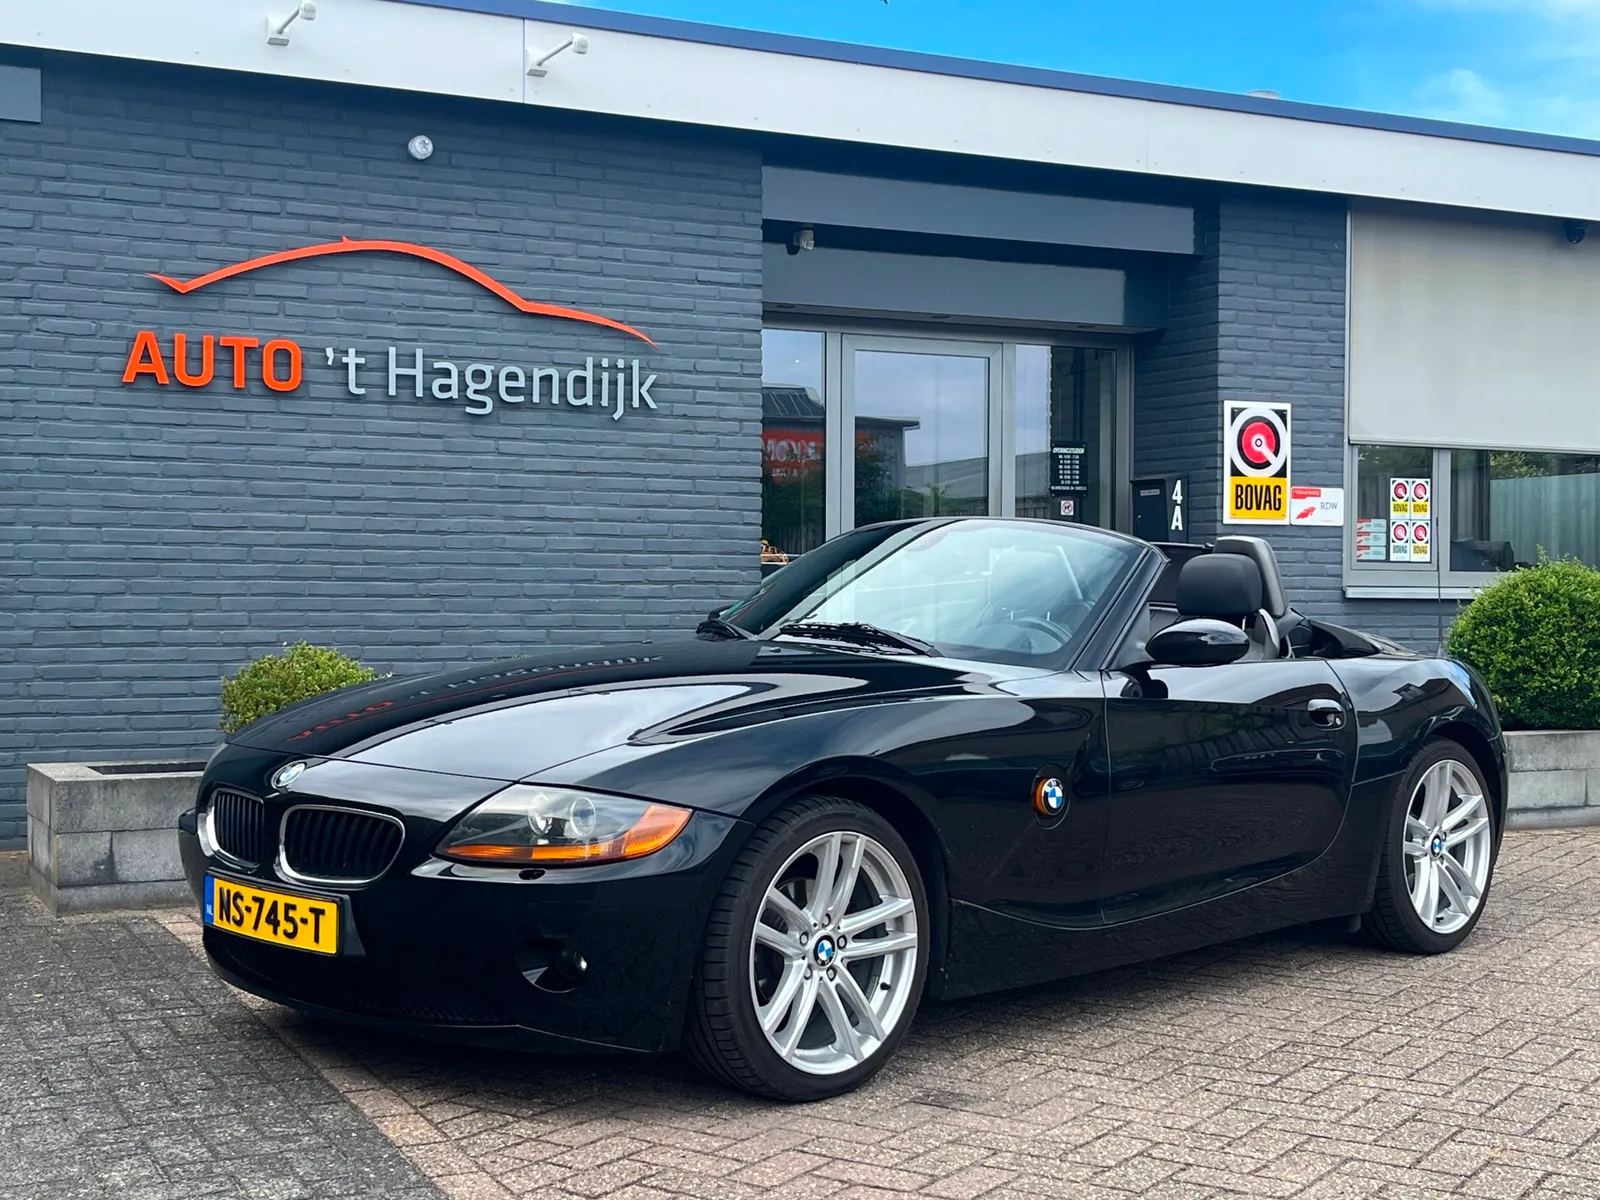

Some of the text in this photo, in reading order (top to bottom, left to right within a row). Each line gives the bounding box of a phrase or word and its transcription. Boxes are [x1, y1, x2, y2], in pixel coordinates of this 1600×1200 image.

[122, 330, 659, 421] AUTO 't Hagendijk
[1235, 484, 1282, 511] BOVAG
[1320, 502, 1338, 510] RDW
[218, 886, 326, 944] NS-745-T
